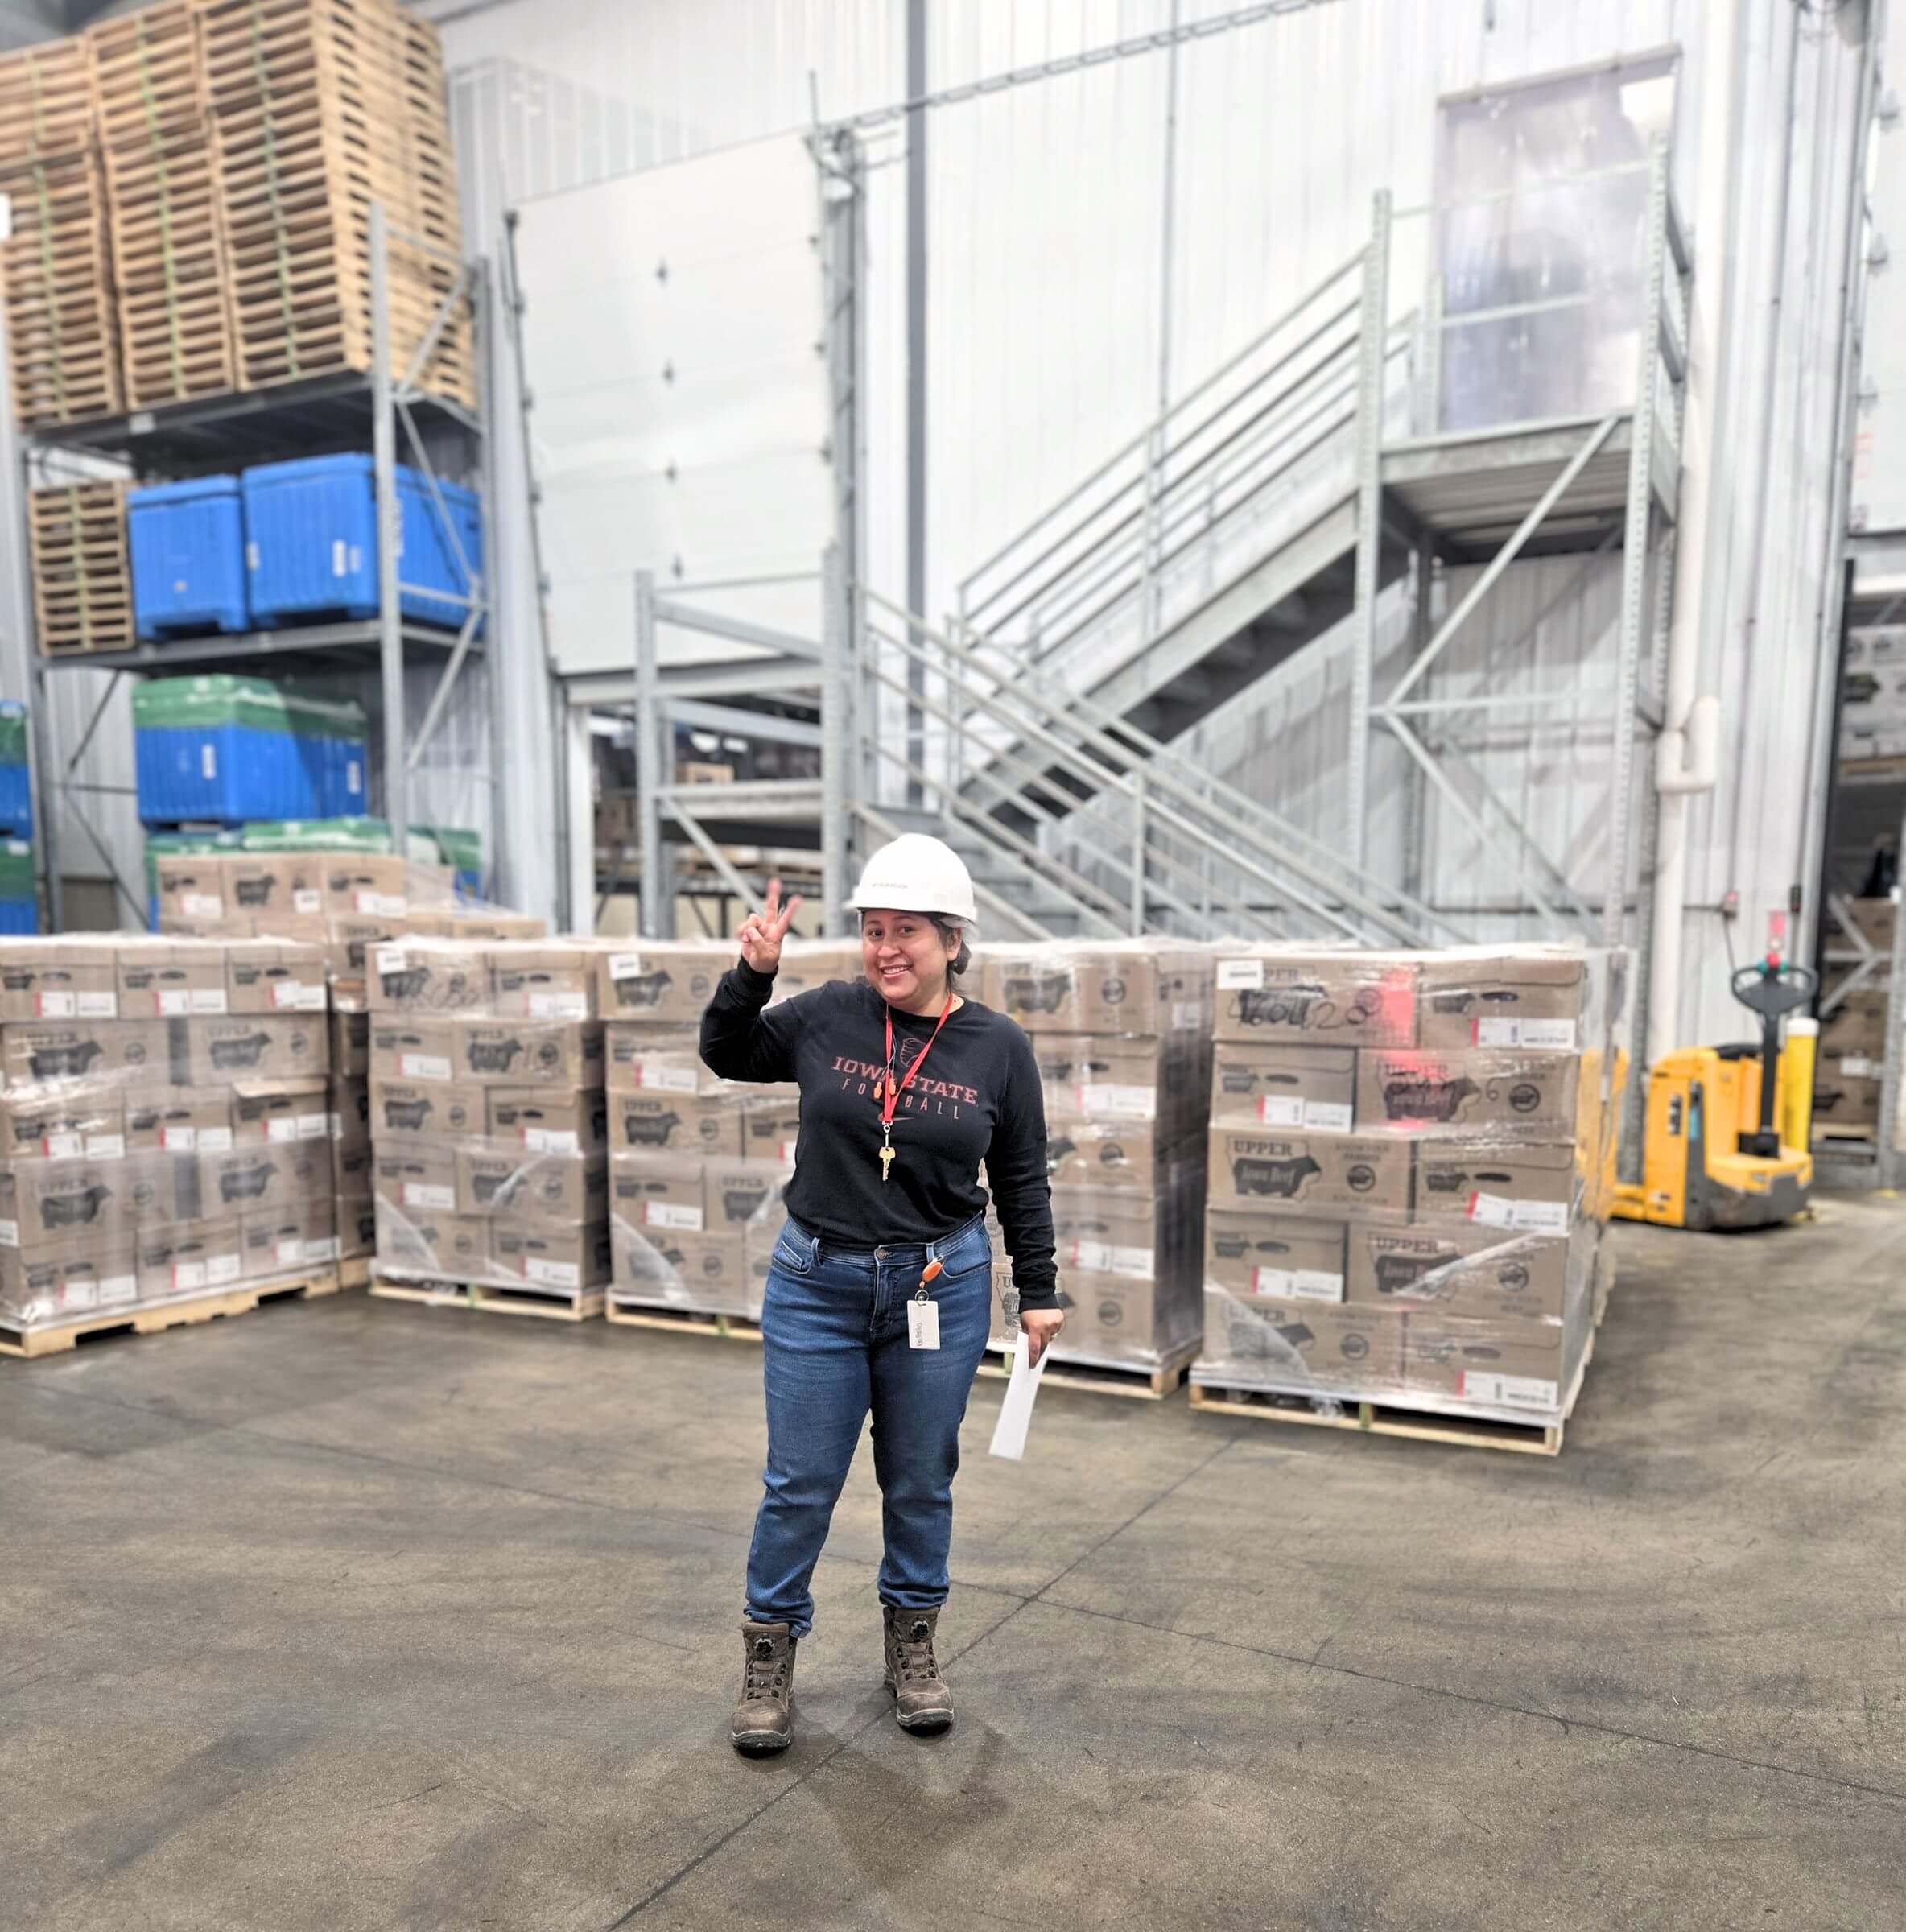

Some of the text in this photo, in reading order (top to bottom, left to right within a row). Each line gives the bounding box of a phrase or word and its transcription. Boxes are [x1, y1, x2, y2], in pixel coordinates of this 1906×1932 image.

[831, 1056, 891, 1081] IOW
[842, 1078, 959, 1120] FOBALL
[1233, 1139, 1293, 1156] UPPER
[1376, 1236, 1439, 1253] UPPER
